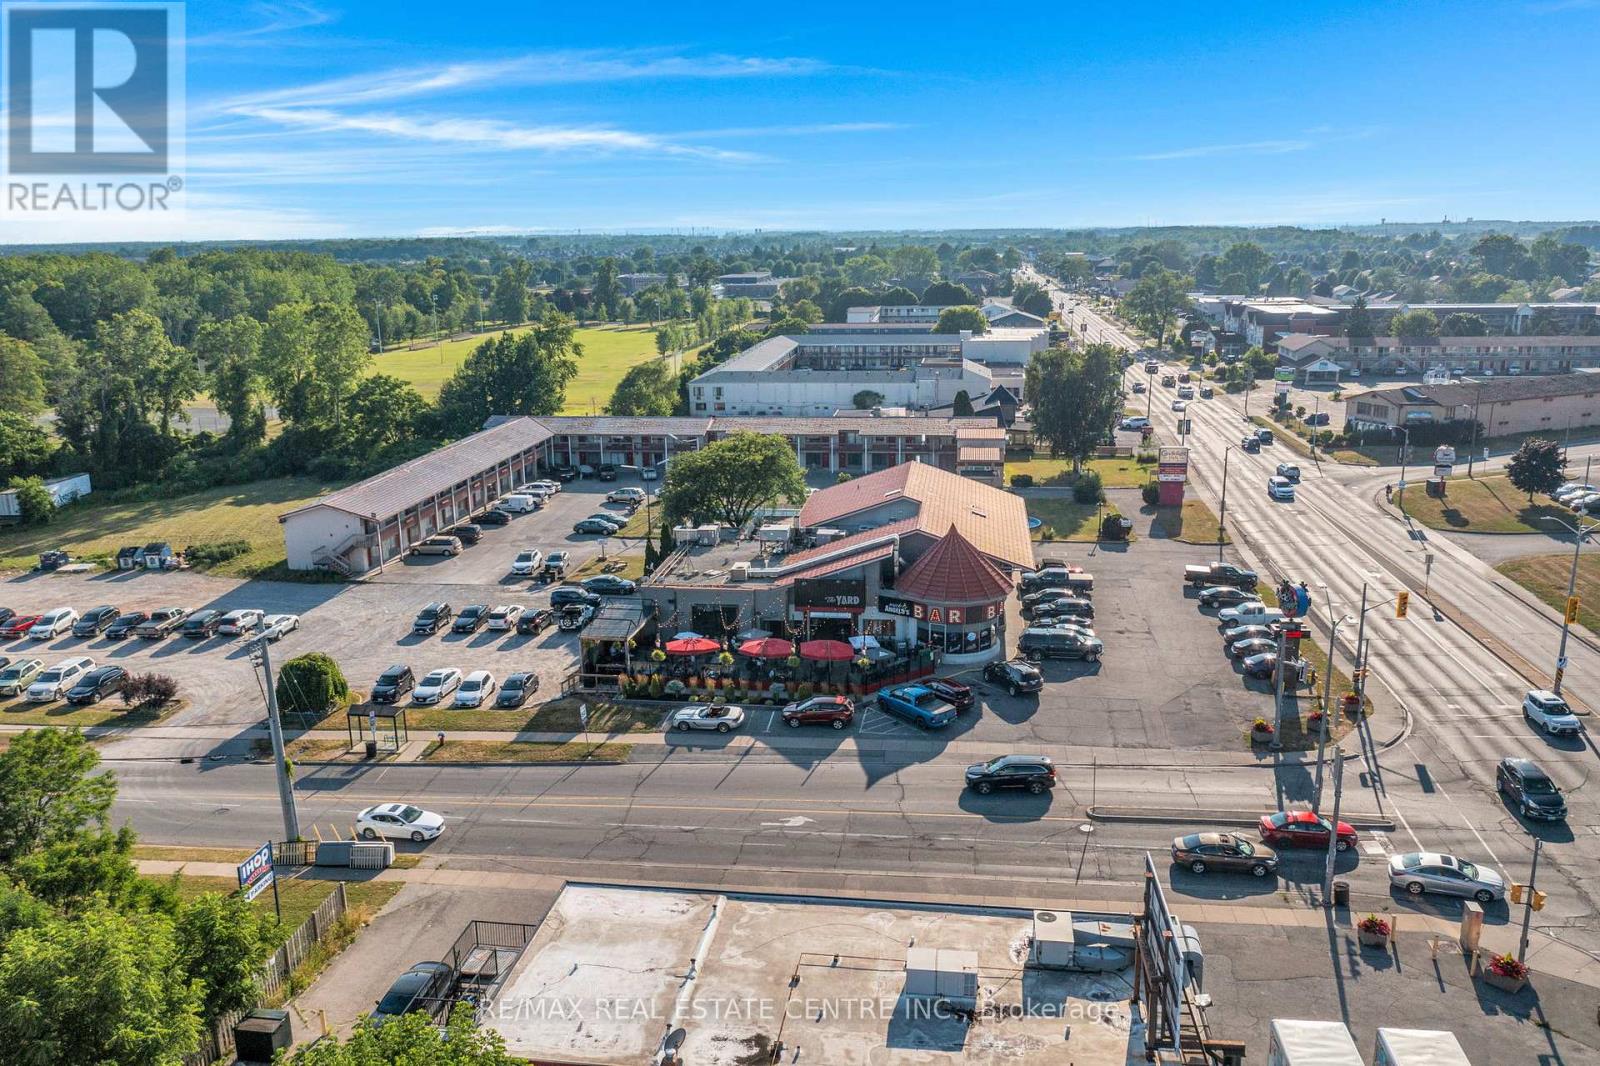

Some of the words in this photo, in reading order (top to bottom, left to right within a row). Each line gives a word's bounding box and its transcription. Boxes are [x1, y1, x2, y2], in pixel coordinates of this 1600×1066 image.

[835, 595, 860, 606] YARD
[913, 604, 961, 623] BAR
[242, 848, 269, 879] IHOP
